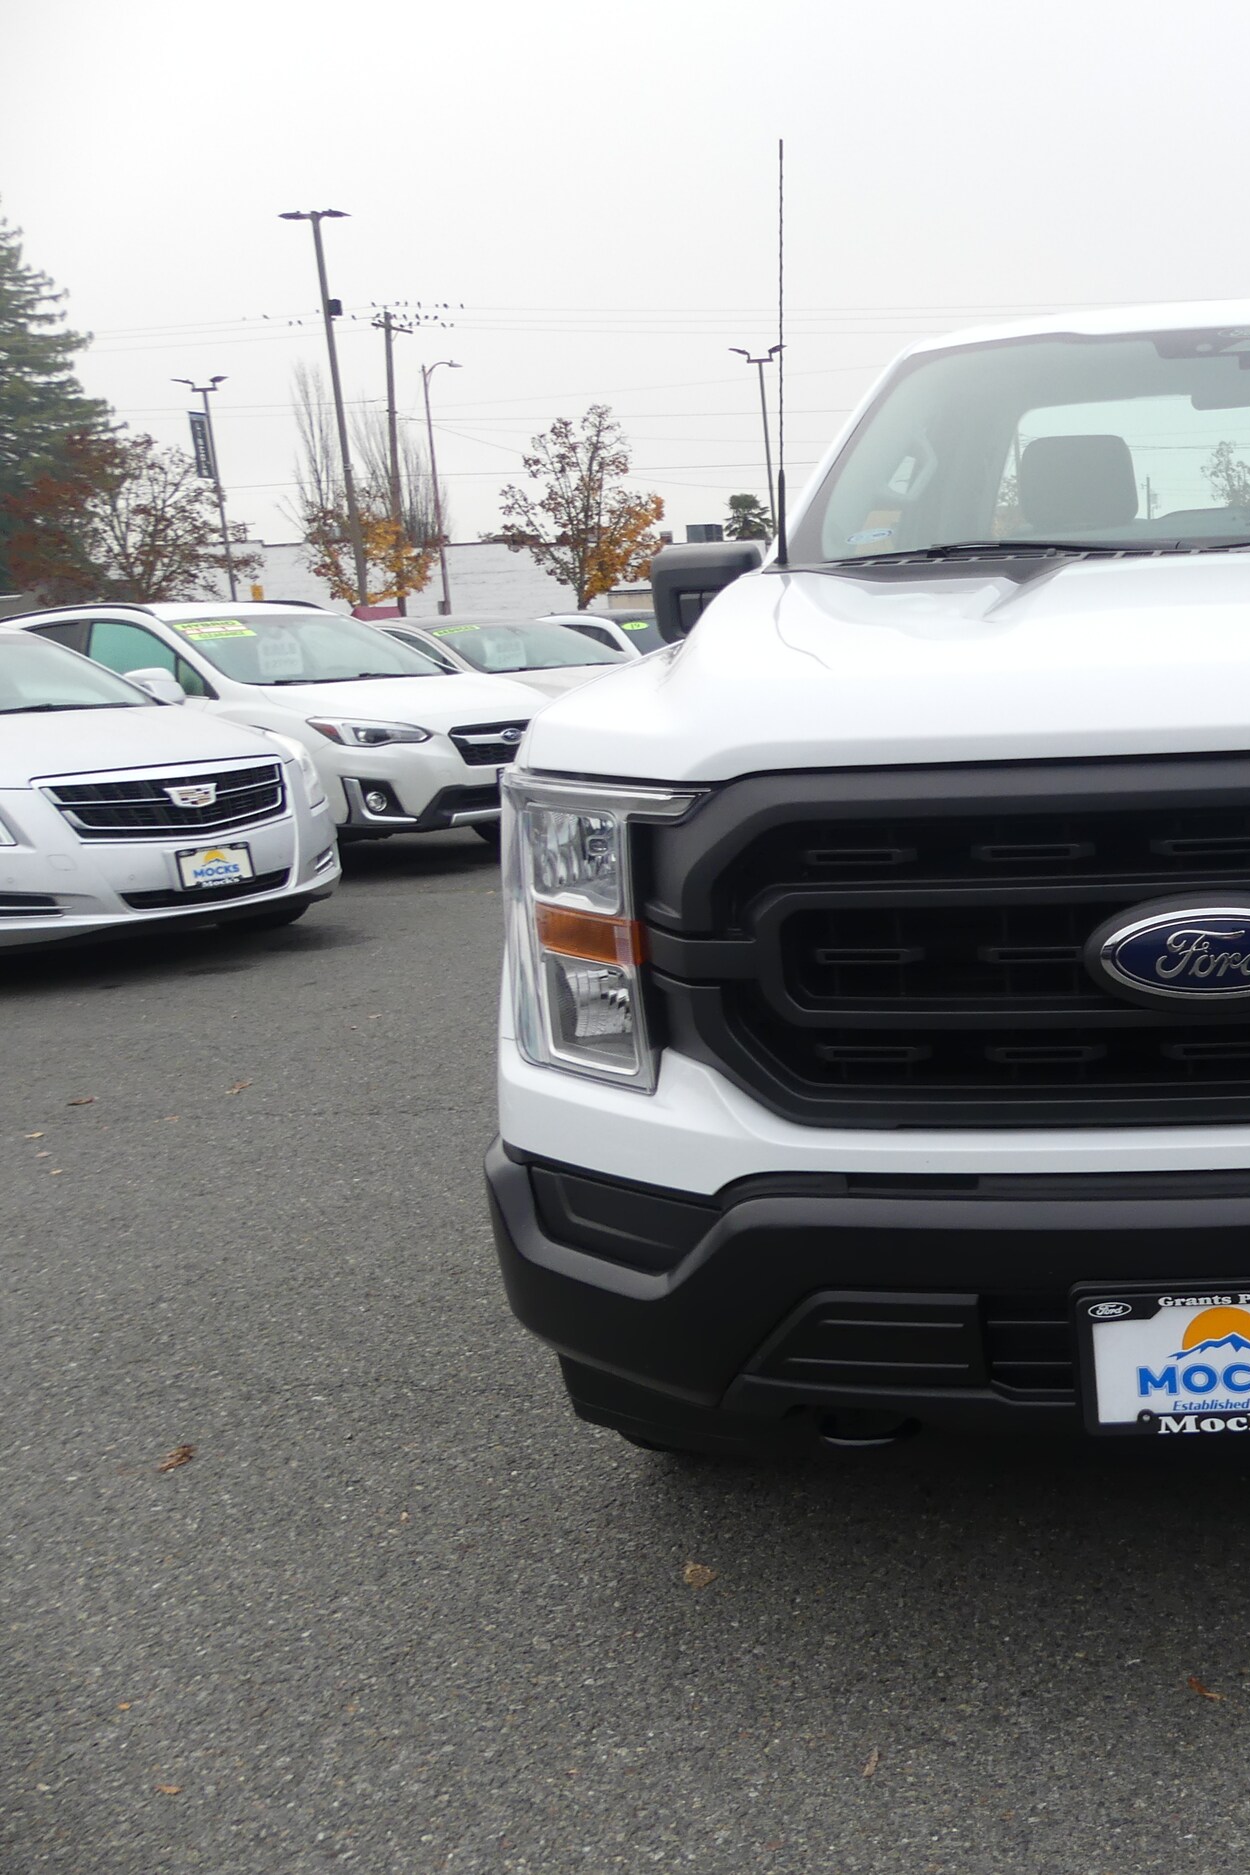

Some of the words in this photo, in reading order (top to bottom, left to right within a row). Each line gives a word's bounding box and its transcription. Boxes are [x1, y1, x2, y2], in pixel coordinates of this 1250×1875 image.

[193, 864, 240, 878] MOCKS
[1157, 1294, 1232, 1308] Grants
[1172, 1397, 1250, 1412] Established
